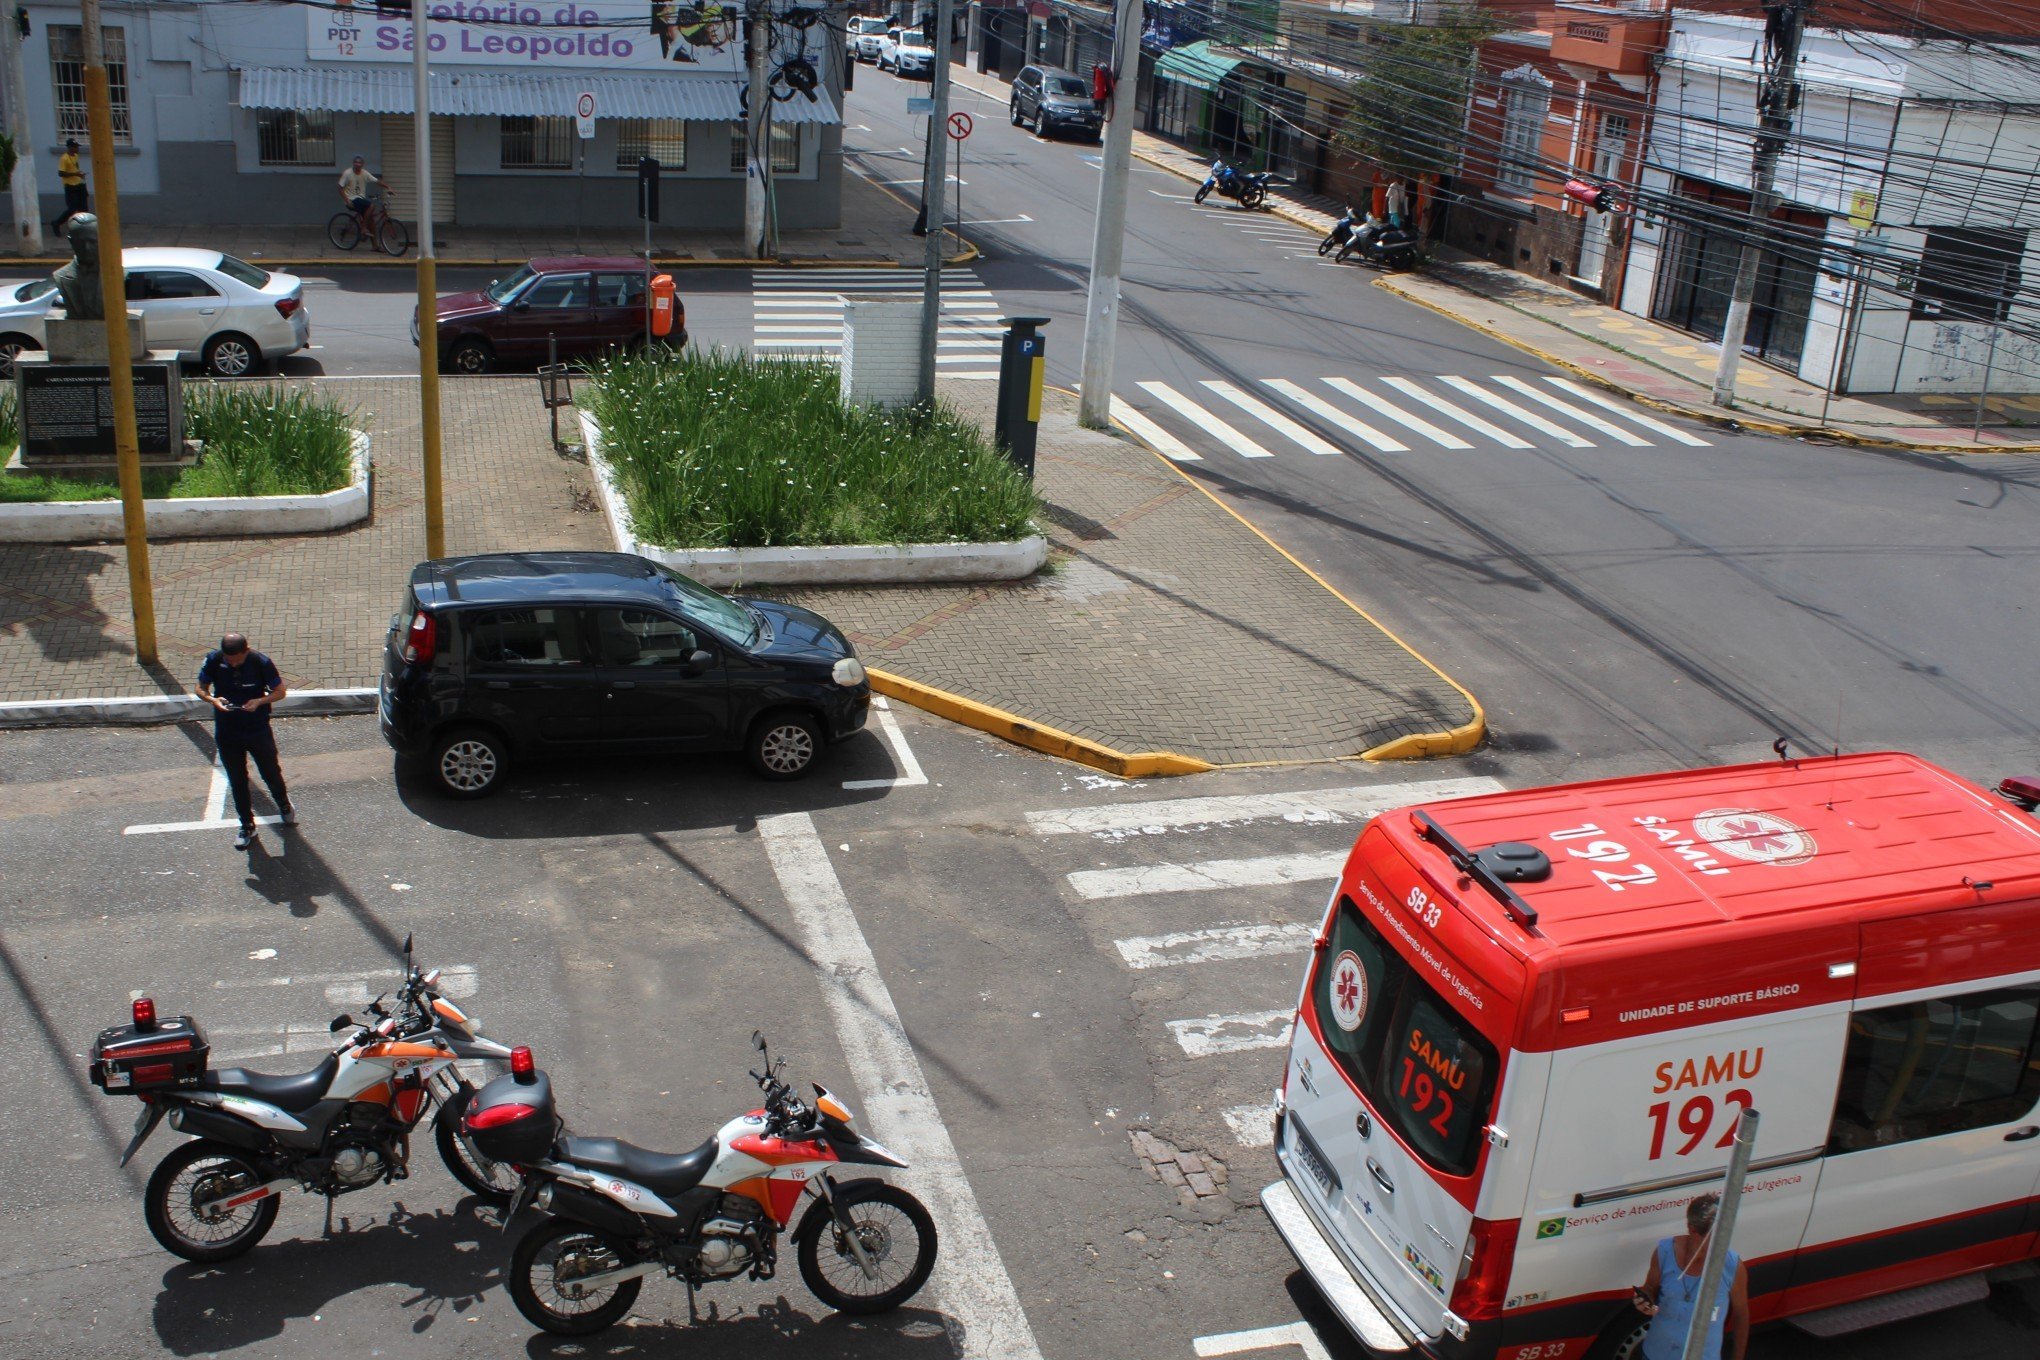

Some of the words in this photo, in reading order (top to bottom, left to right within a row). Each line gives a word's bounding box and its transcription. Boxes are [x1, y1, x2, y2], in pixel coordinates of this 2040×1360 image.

[376, 0, 542, 26] etório
[554, 3, 599, 27] de
[328, 28, 361, 42] PDT
[337, 43, 354, 56] 12
[461, 29, 634, 61] Leopoldo
[1023, 340, 1033, 352] P
[1548, 823, 1658, 892] 192
[1633, 815, 1732, 875] SAMU
[1407, 886, 1427, 914] SB
[1423, 903, 1442, 928] 33
[1359, 879, 1378, 905] Serviço
[1376, 900, 1386, 914] de
[1383, 908, 1421, 953] Atendimento
[1419, 946, 1443, 973] Móvel
[1440, 966, 1452, 981] de
[1451, 974, 1484, 1010] Urgência
[1619, 1004, 1675, 1023] UNIDADE
[1677, 1000, 1694, 1013] DE
[1697, 991, 1753, 1010] SUPORTE
[1755, 983, 1800, 1000] BÁSICO
[1408, 1029, 1466, 1091] SAMU
[1653, 1046, 1764, 1094] SAMU
[1400, 1057, 1454, 1138] 192
[1648, 1088, 1754, 1161] 192
[627, 1189, 640, 1201] 192
[791, 1172, 805, 1180] 192
[1565, 1211, 1609, 1229] Serviço
[1611, 1206, 1626, 1220] de
[1757, 1174, 1802, 1192] Urgência
[1516, 1345, 1542, 1360] SB
[1543, 1342, 1566, 1358] 33
